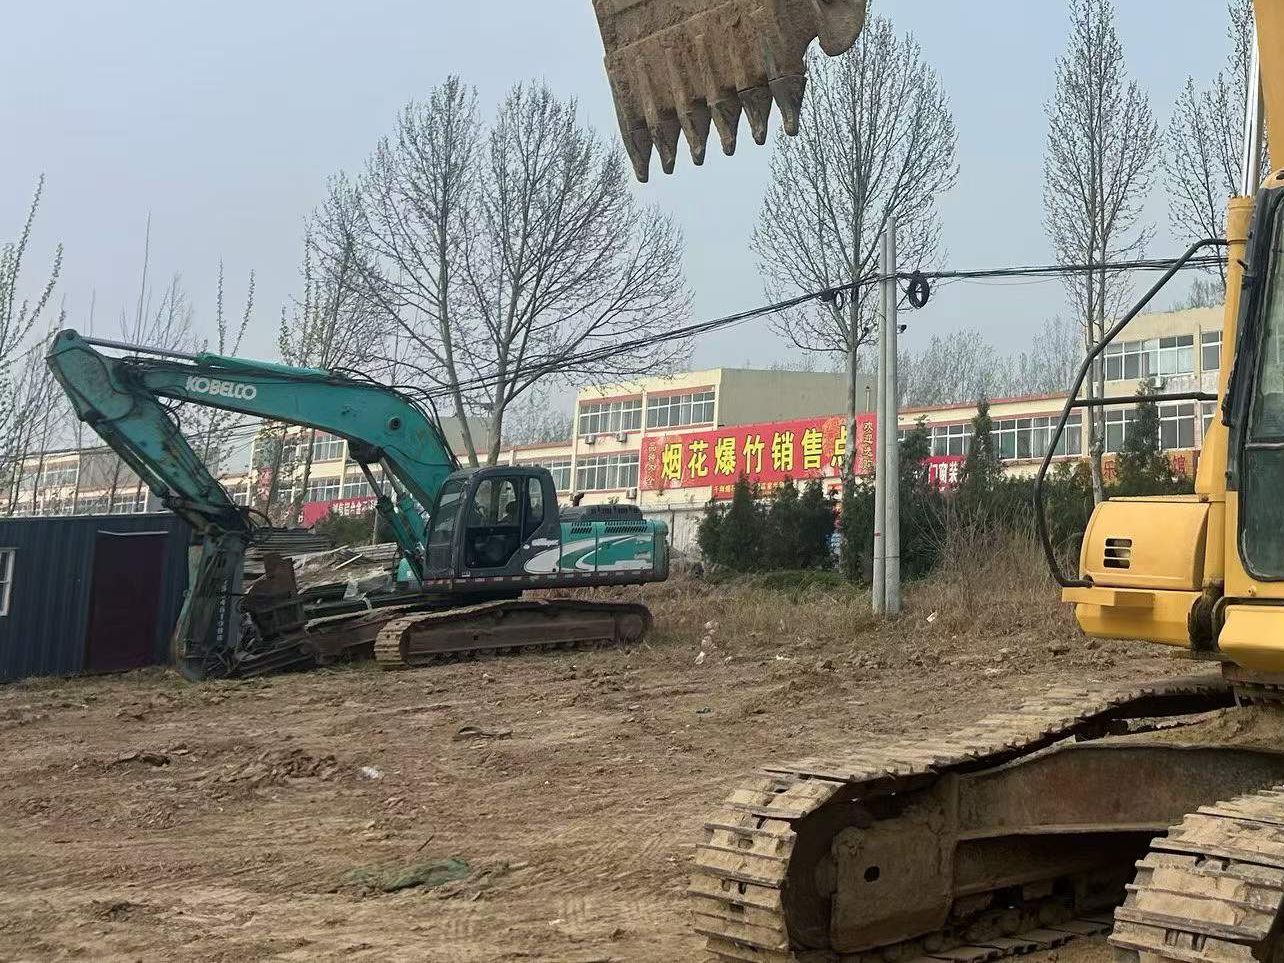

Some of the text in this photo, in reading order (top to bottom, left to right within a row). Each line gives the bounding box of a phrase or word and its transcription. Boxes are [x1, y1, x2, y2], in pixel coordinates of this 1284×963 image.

[185, 376, 257, 400] KOBELCO
[661, 425, 848, 480] 烟花爆竹销售点
